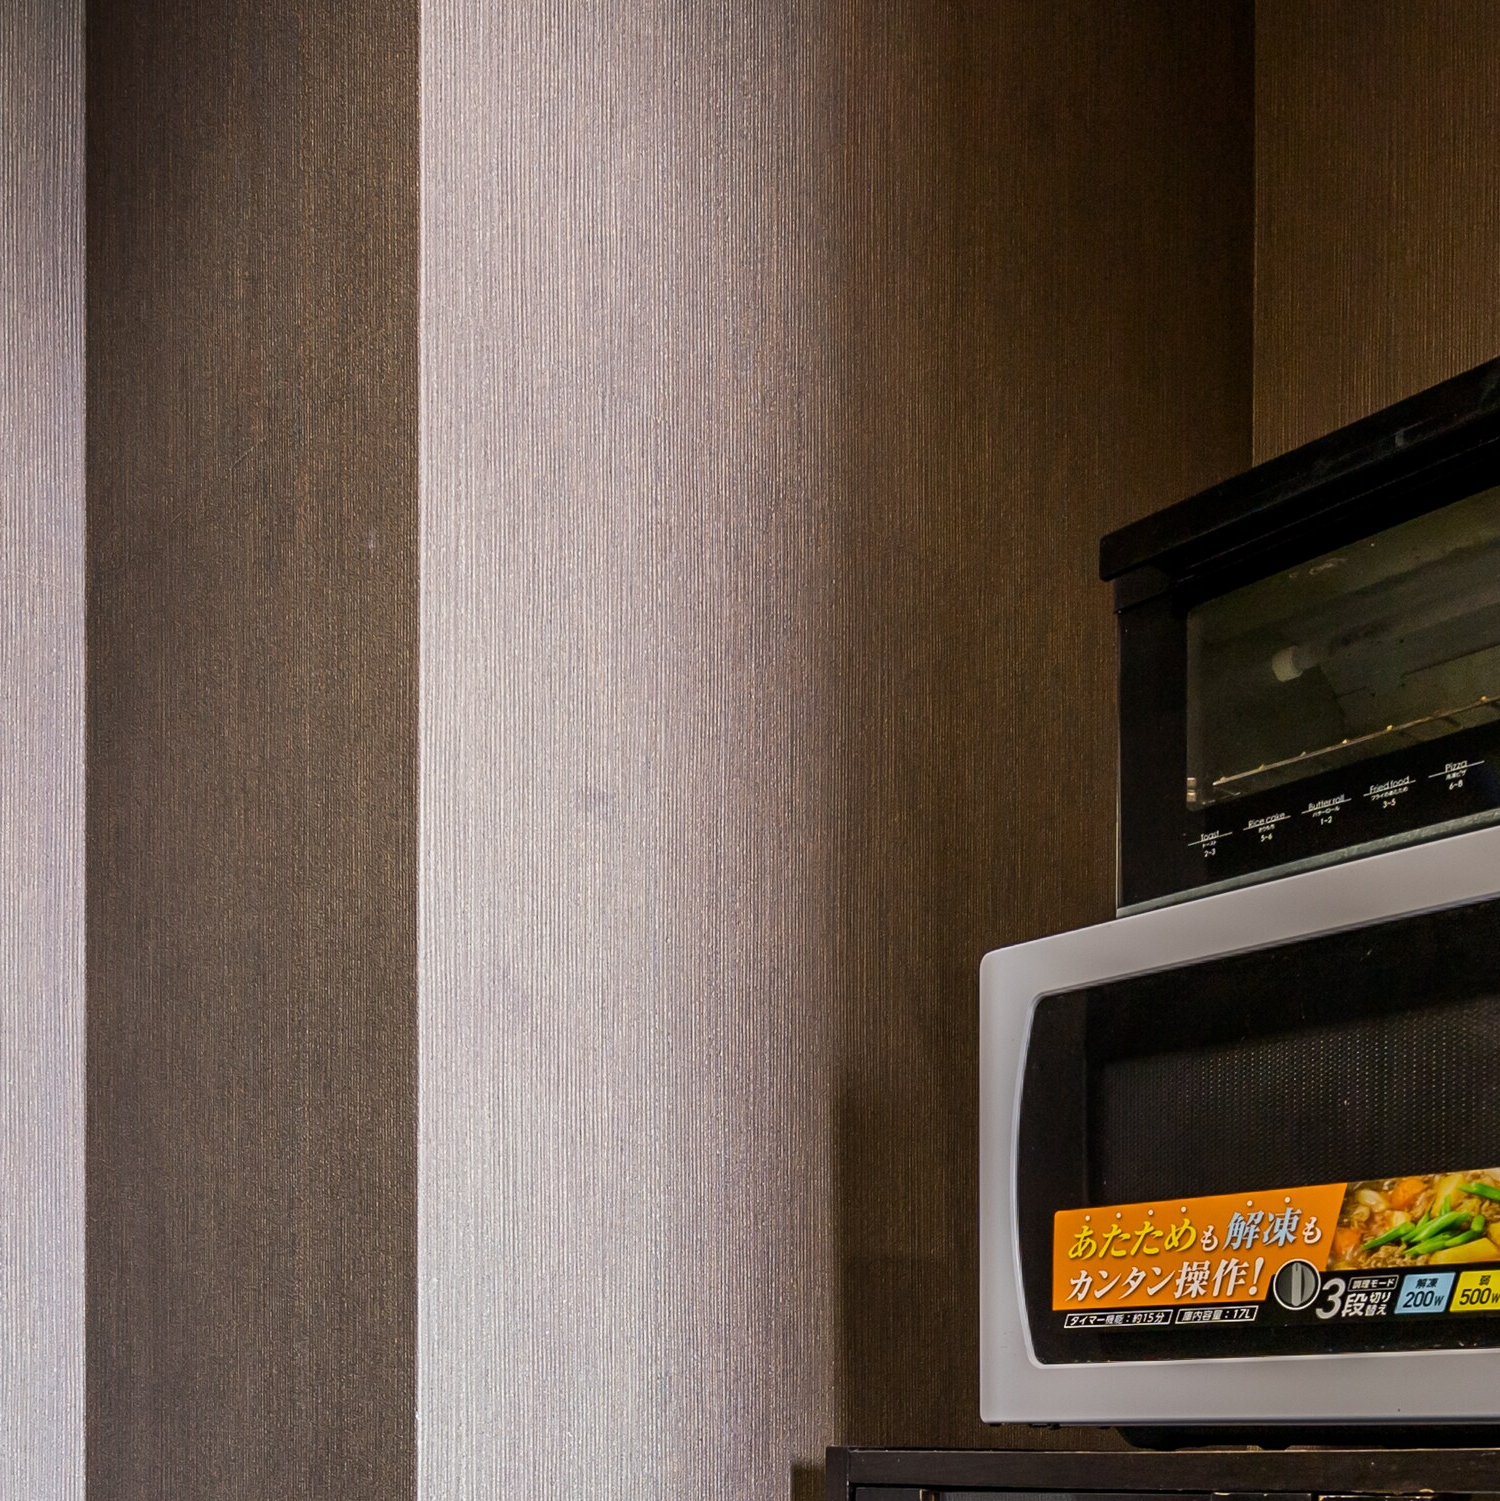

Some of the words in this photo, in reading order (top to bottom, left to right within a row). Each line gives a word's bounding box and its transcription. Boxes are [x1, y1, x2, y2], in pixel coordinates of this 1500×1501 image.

[1444, 760, 1468, 773] Pizza
[1369, 782, 1389, 794] Fried
[1390, 776, 1410, 787] food
[1308, 798, 1331, 811] Butter
[1332, 794, 1345, 805] roll
[1248, 818, 1265, 828] Rice
[1266, 812, 1286, 824] cake
[1200, 830, 1220, 842] Toast
[1067, 1207, 1323, 1260] あたためも解凍も
[1065, 1256, 1266, 1302] カンタン操作!
[1351, 1277, 1396, 1291] 調理モード
[1414, 1276, 1438, 1289] 解凍
[1478, 1274, 1491, 1286] 弱
